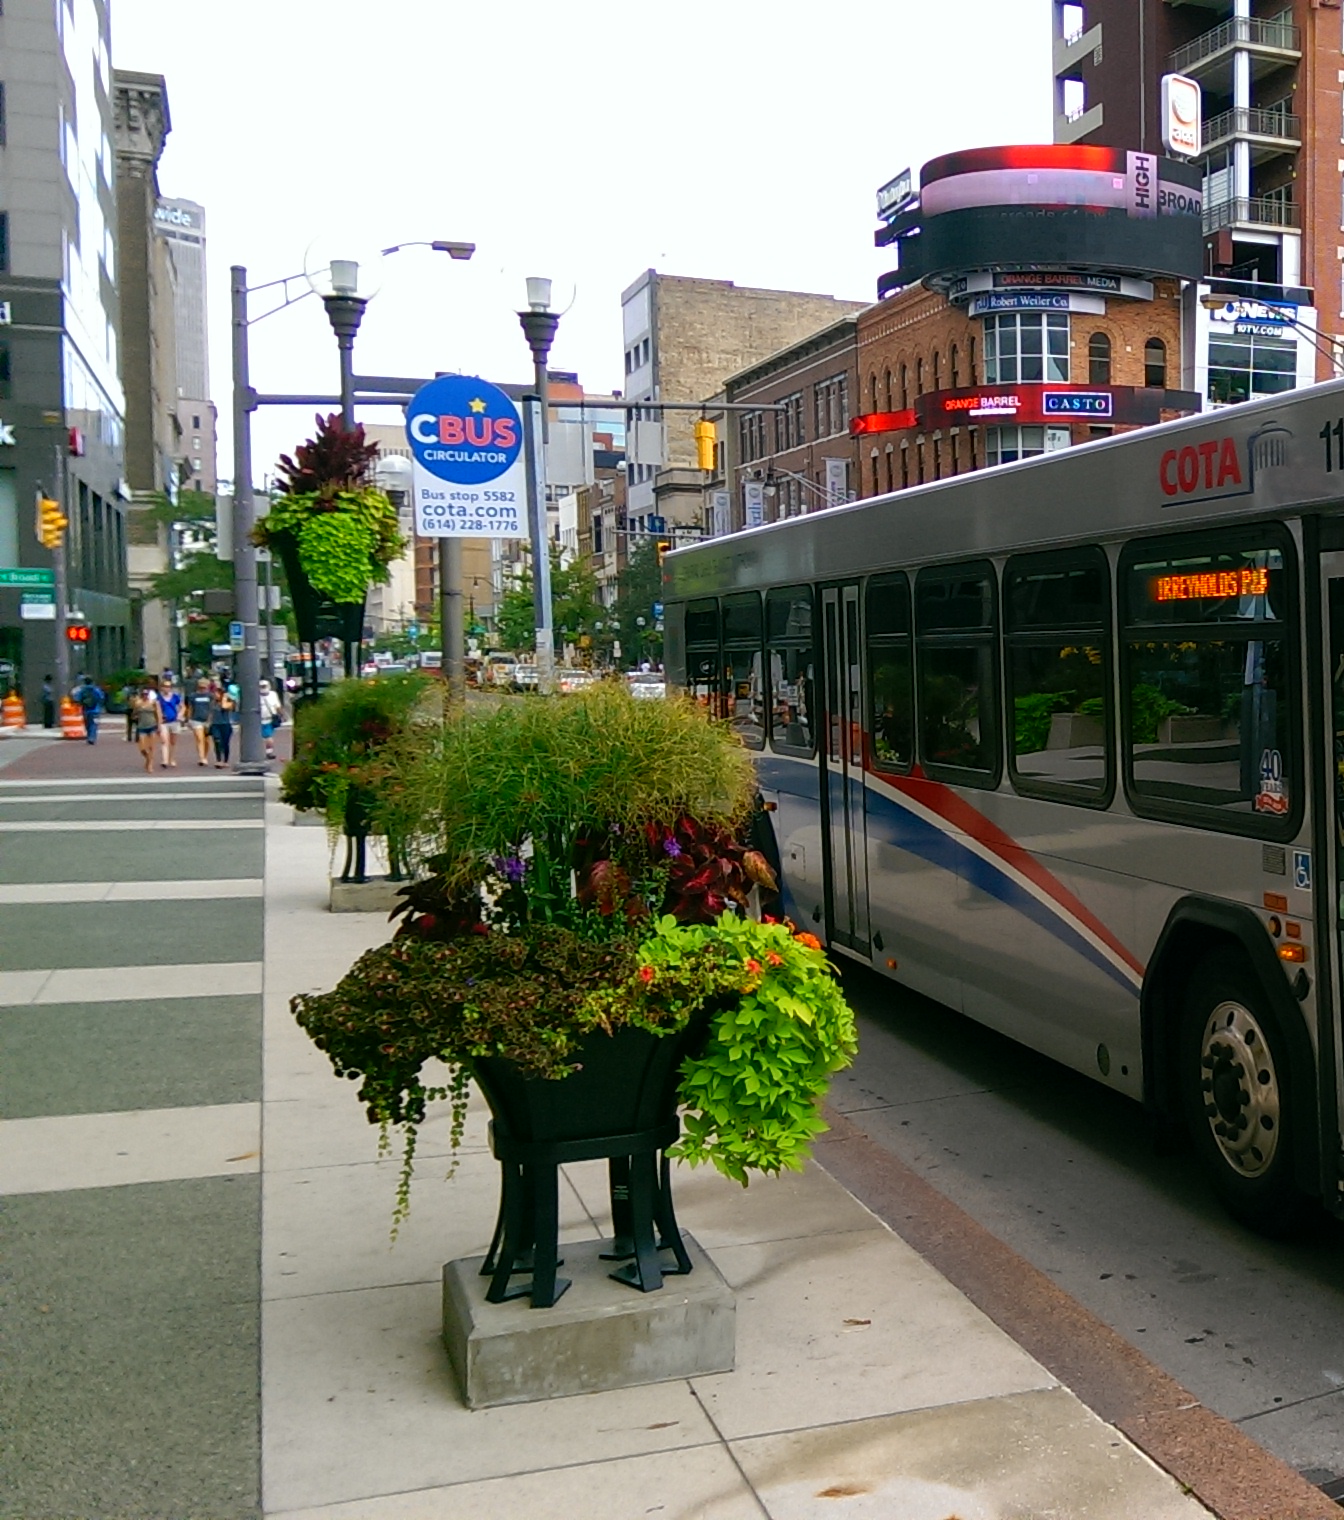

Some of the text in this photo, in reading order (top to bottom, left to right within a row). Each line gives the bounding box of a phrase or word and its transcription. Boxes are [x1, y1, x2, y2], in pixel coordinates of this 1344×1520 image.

[1135, 156, 1150, 209] HIGH
[1158, 189, 1202, 216] BROAD
[1001, 273, 1117, 289] ORANGE BARREL MEDIA
[991, 294, 1018, 308] Robert
[1020, 295, 1050, 307] Weiler
[1236, 324, 1282, 336] 10TV.COM
[945, 395, 1021, 411] ORANGE BARREL
[1049, 399, 1106, 410] CASTO
[410, 413, 516, 448] CBUS
[423, 449, 507, 464] CIRCULATOR
[1159, 437, 1242, 496] COTA
[421, 488, 516, 504] Bus stop 5582
[422, 503, 517, 519] cota.com
[422, 517, 518, 531] (614) 228-1776
[1259, 748, 1283, 782] 40
